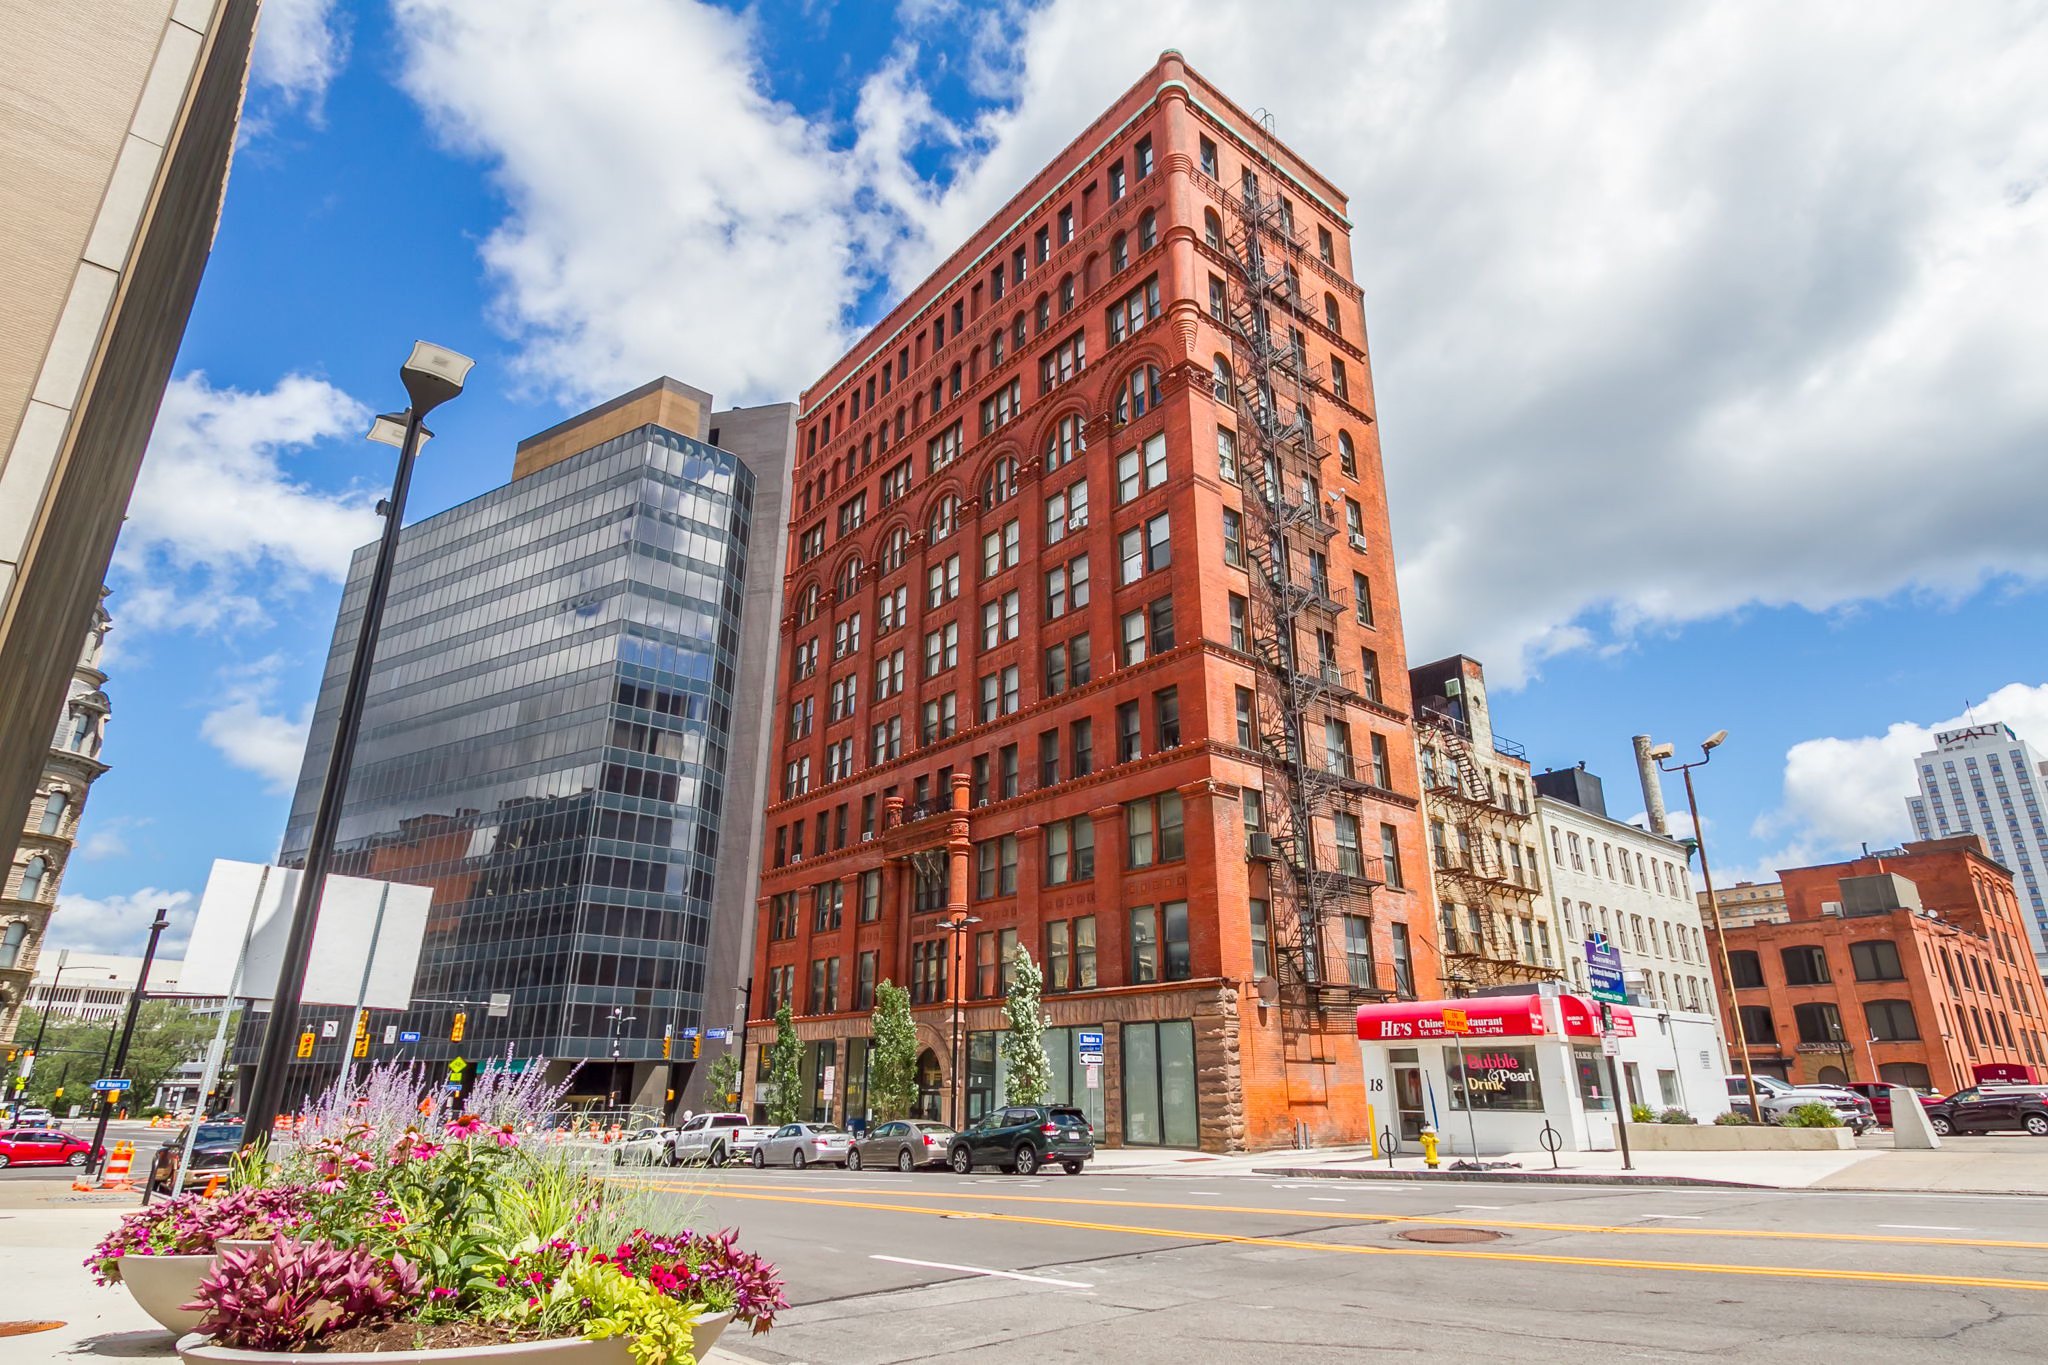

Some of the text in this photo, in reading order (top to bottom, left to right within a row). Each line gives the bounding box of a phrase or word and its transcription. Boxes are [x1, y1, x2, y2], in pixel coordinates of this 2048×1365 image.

[1937, 723, 1998, 744] HYATT
[1418, 1018, 1445, 1029] Chine
[1466, 1053, 1519, 1069] Bubble
[1574, 1051, 1592, 1060] TAKE
[1500, 1068, 1535, 1082] Pearl
[1370, 1078, 1383, 1092] 18
[1468, 1077, 1506, 1091] Drink
